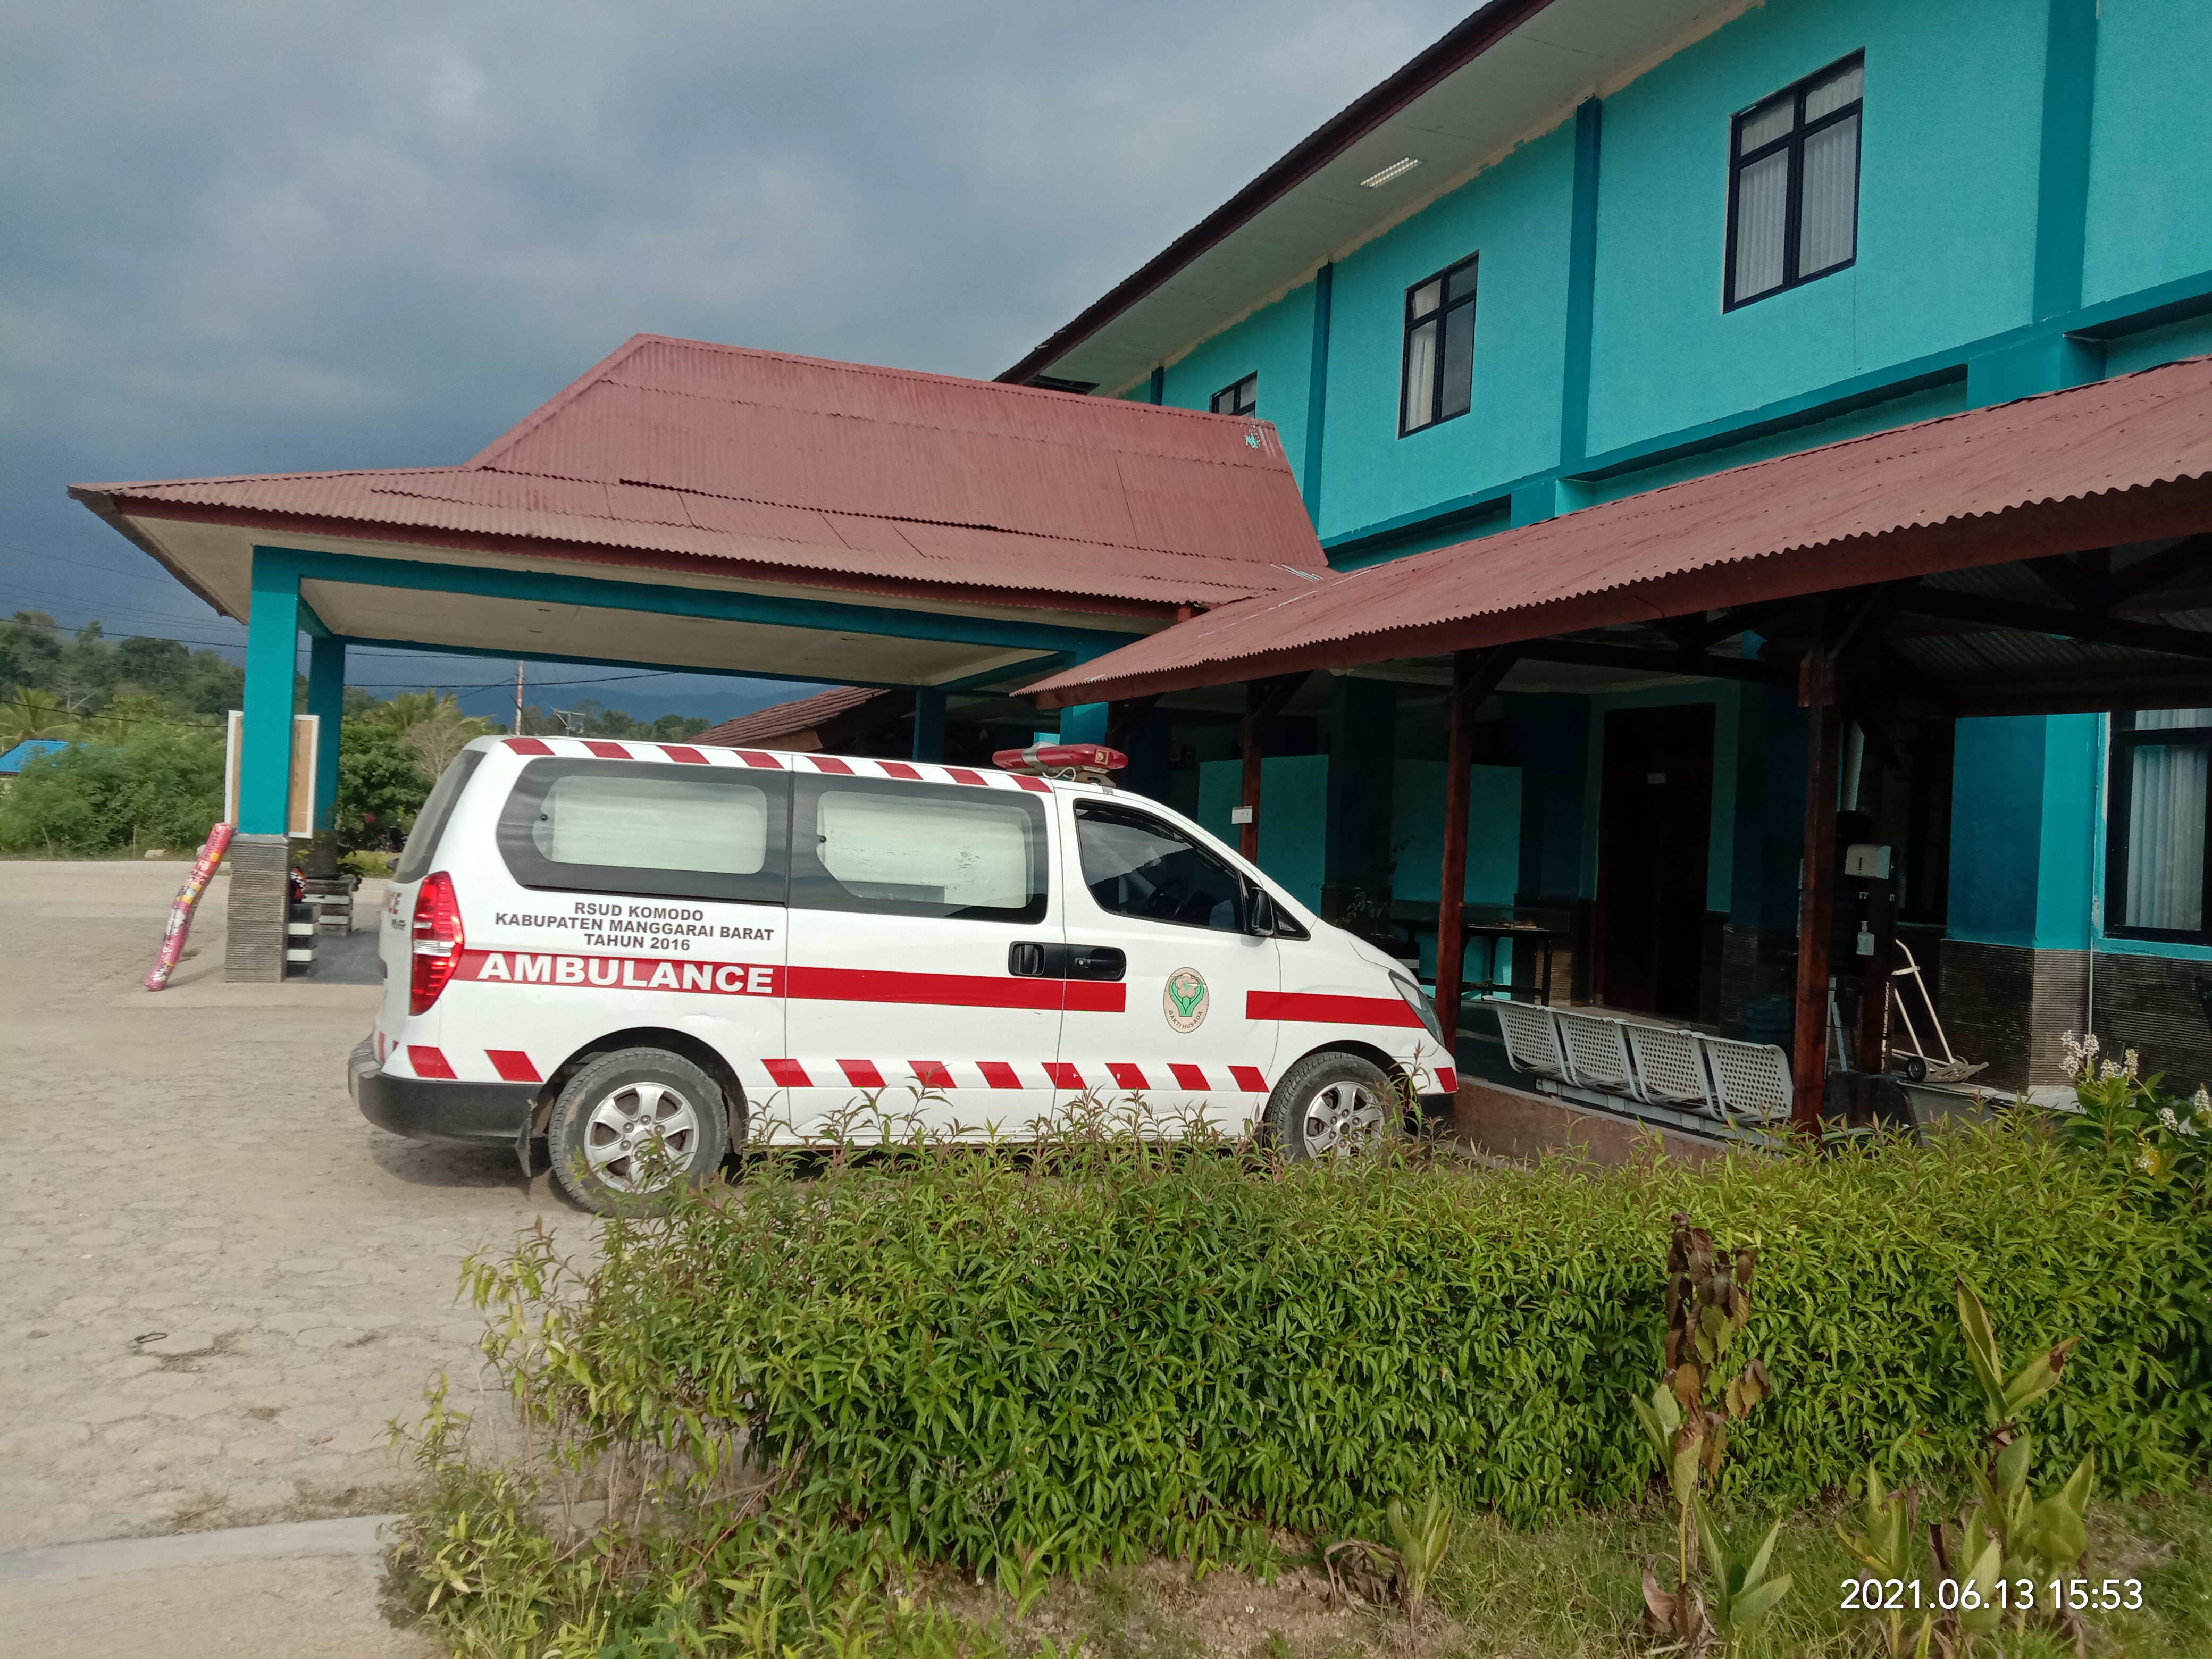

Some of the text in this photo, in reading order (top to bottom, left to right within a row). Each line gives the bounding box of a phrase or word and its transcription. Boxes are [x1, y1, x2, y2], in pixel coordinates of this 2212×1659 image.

[574, 902, 704, 921] RSUD KOMODO
[495, 912, 775, 941] KABUPATEN MANGGARAI BARAT
[584, 933, 691, 951] TAHUN 2016
[476, 952, 774, 994] AMBULANCE
[1169, 1010, 1203, 1029] BAKTI HUSADA
